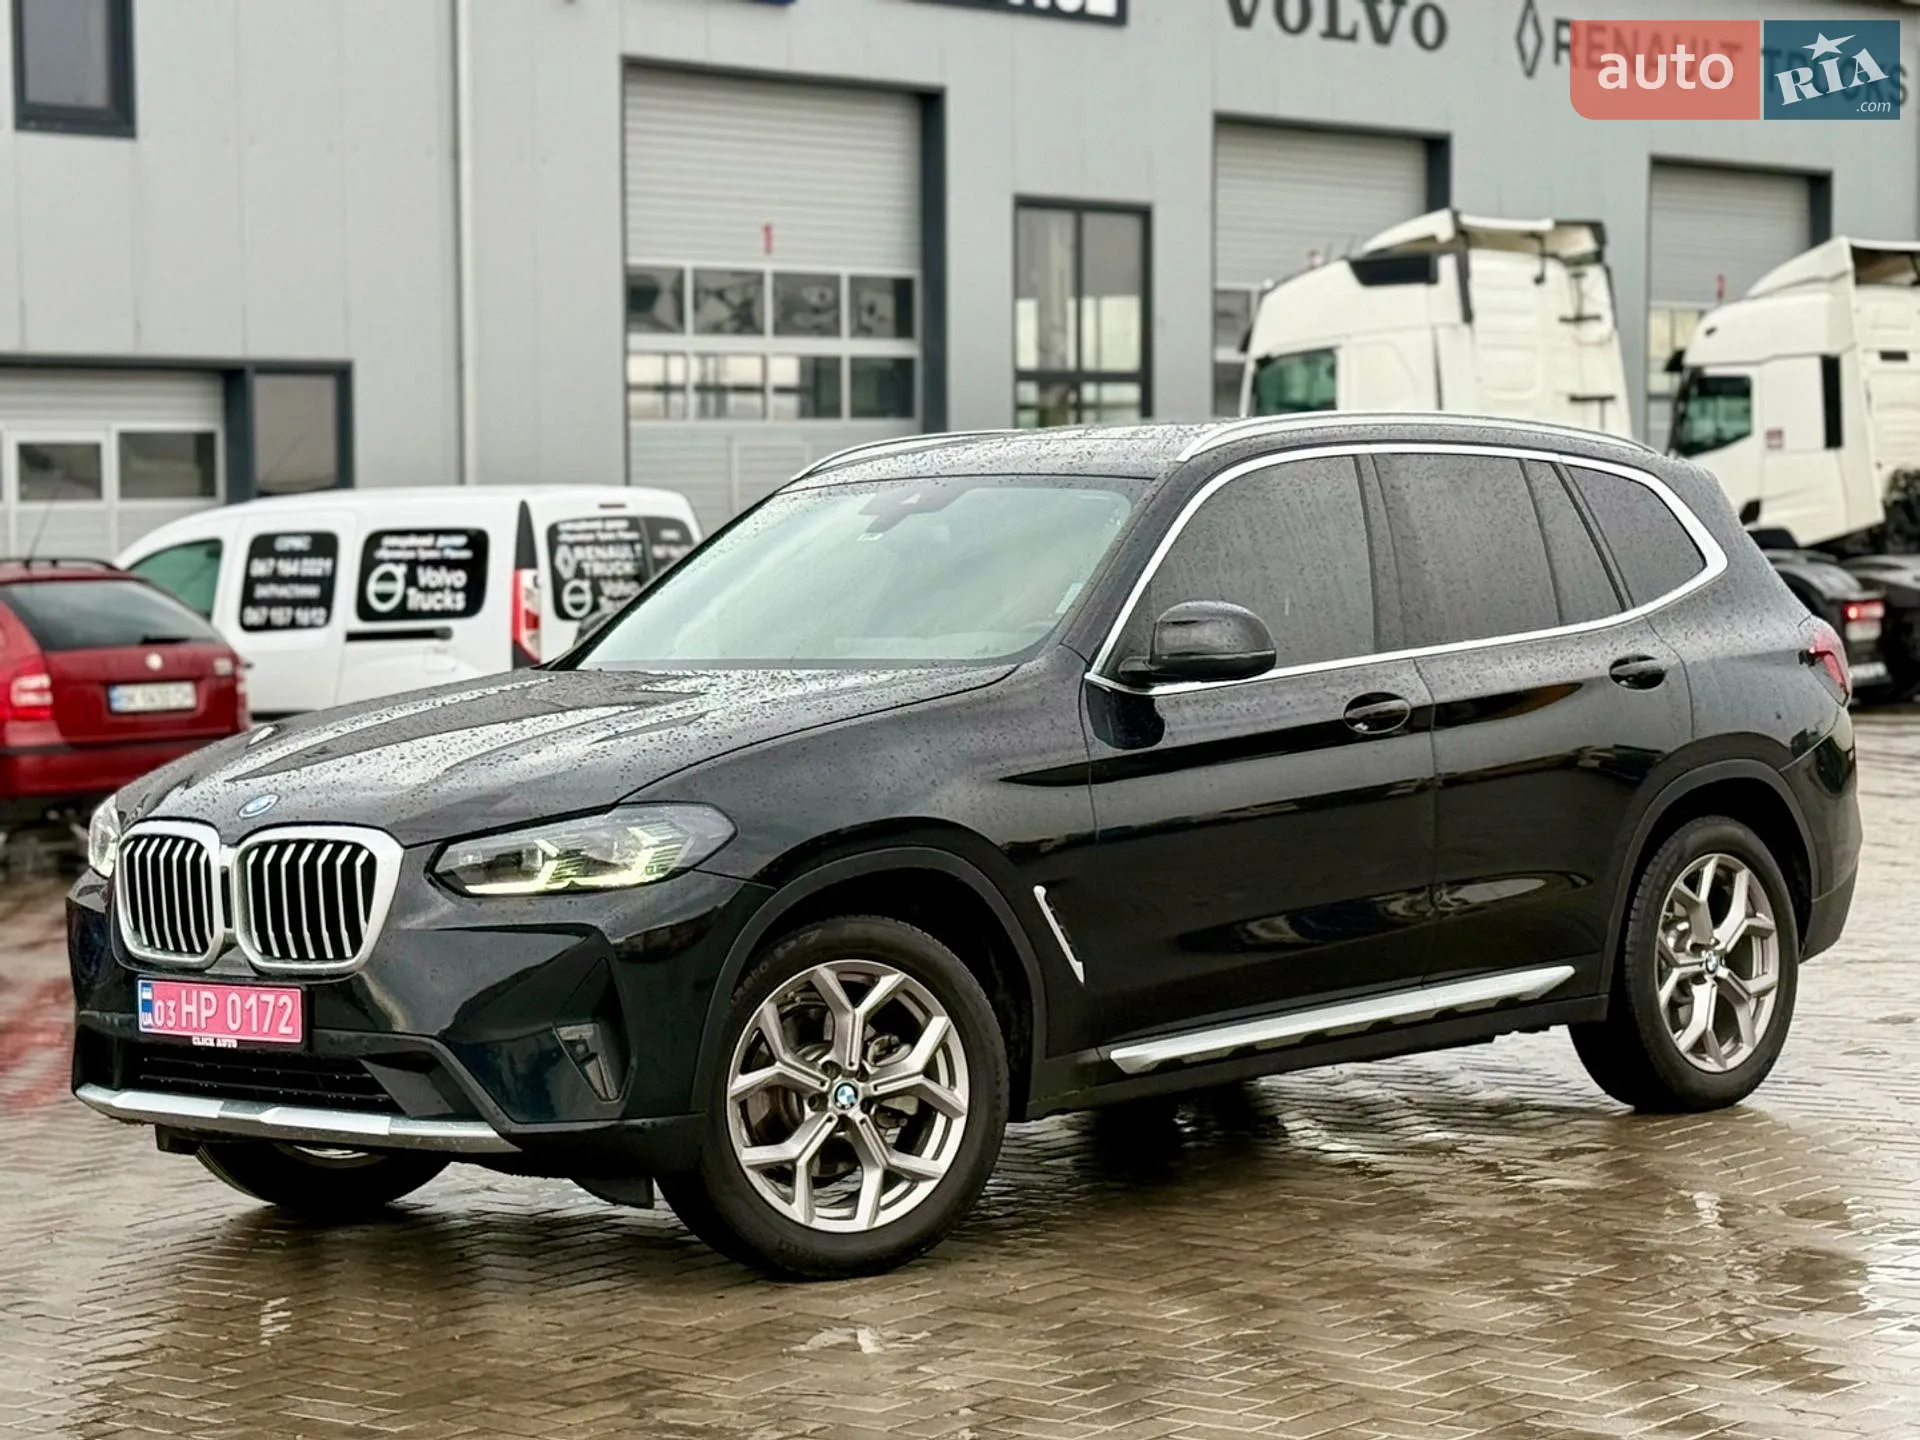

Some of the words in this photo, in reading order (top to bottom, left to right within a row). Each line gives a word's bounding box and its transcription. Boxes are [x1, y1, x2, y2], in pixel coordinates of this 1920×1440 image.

[1227, 0, 1448, 51] VOLVO
[417, 565, 467, 588] Volvo
[406, 587, 466, 611] Trucks
[154, 1000, 176, 1028] 03
[180, 989, 217, 1029] HP
[226, 991, 294, 1034] 0172
